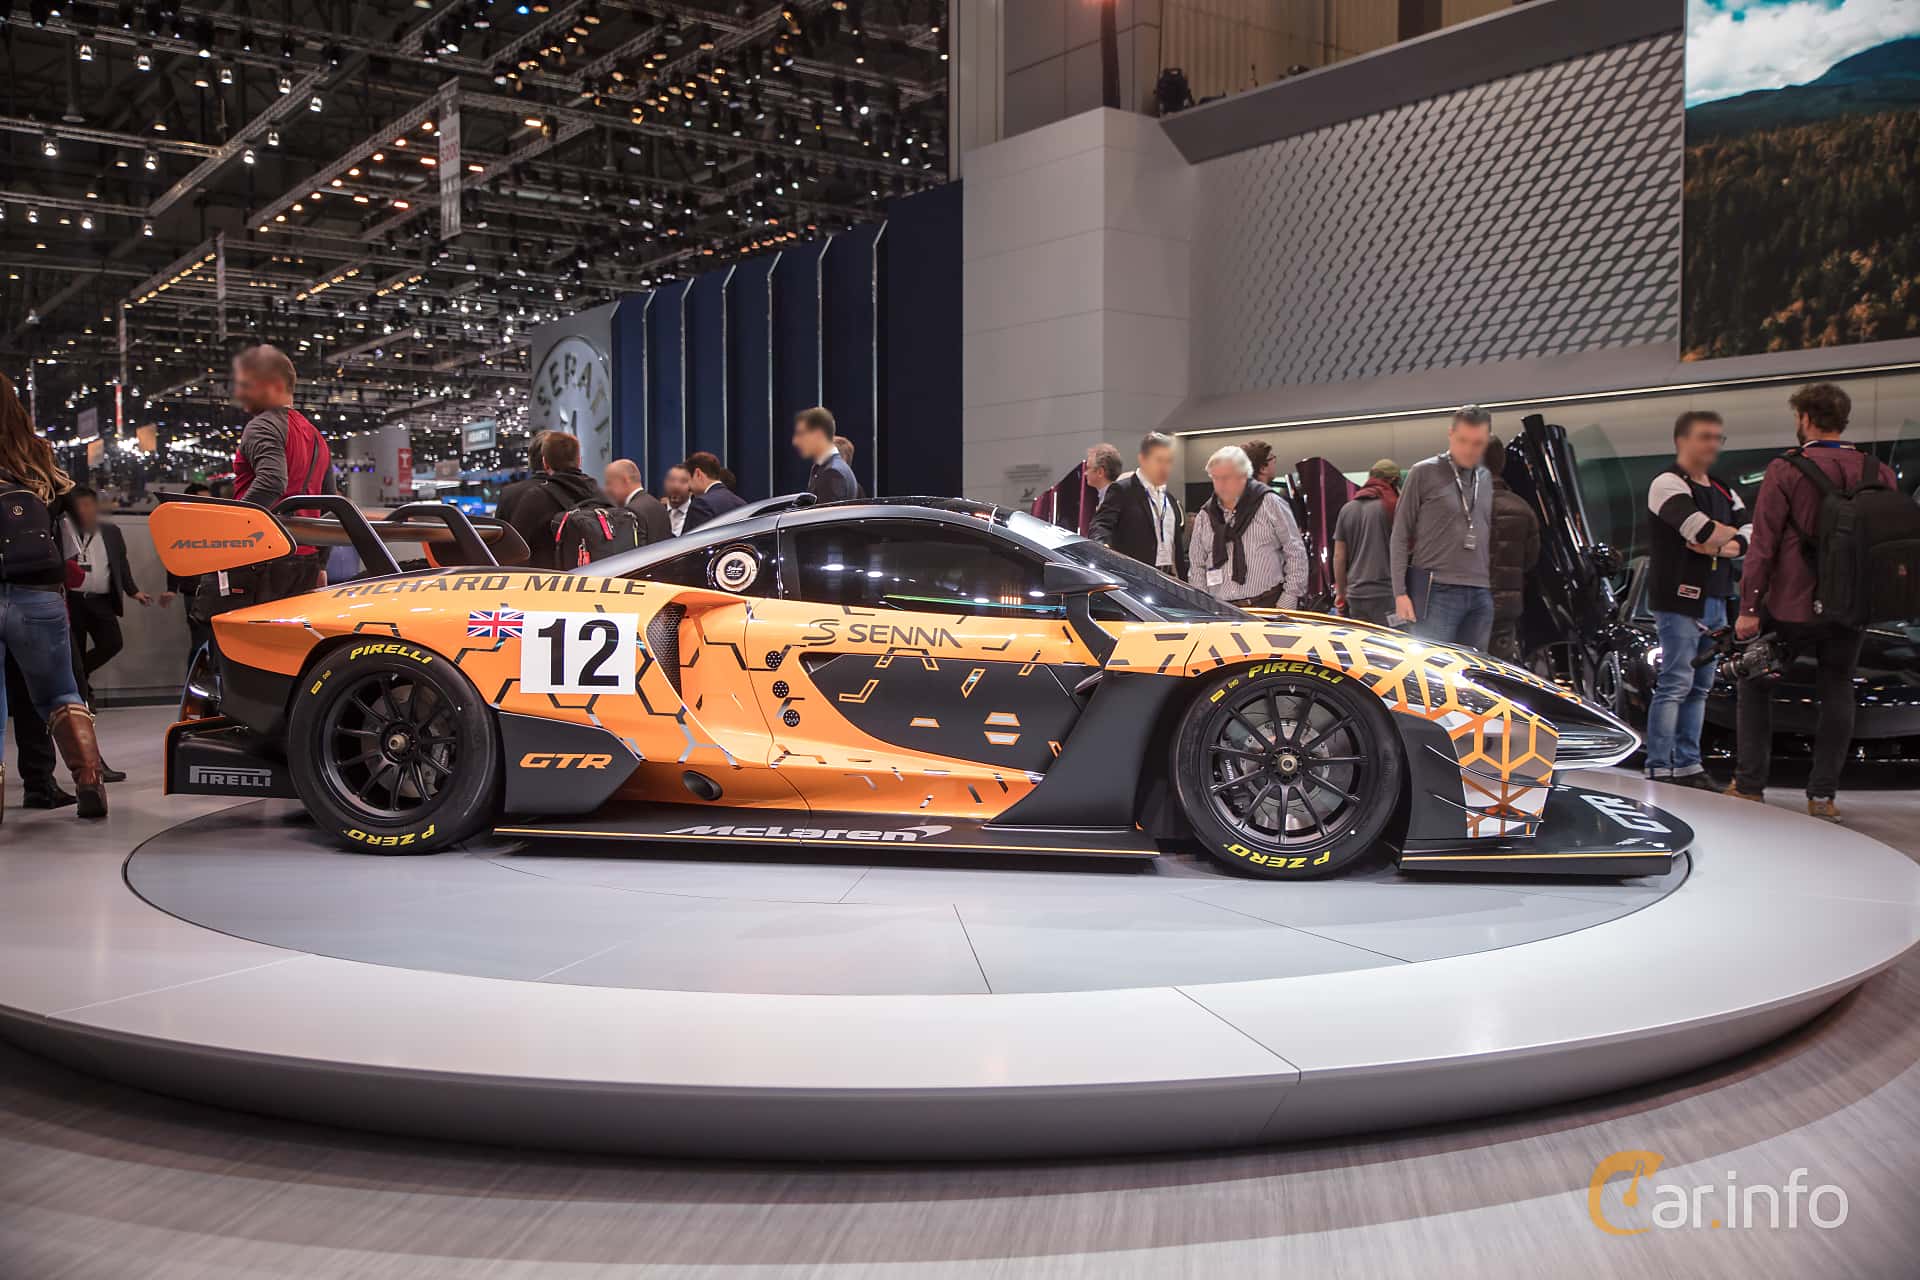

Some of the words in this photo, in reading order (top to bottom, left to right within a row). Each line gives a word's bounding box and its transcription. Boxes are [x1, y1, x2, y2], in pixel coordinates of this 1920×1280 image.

[169, 538, 255, 549] McLaren
[332, 575, 510, 599] RICHARD
[523, 575, 647, 597] MILLE
[847, 623, 963, 649] SENNA
[349, 643, 433, 664] PIRELLI
[537, 617, 620, 687] 12
[1248, 661, 1344, 684] PIRELLI
[519, 752, 613, 769] GTR
[189, 765, 273, 787] PIRELLI
[347, 828, 416, 847] ZERO
[421, 824, 435, 840] P
[665, 824, 917, 842] McLaren
[1227, 843, 1308, 868] ZERO
[1313, 850, 1331, 866] P
